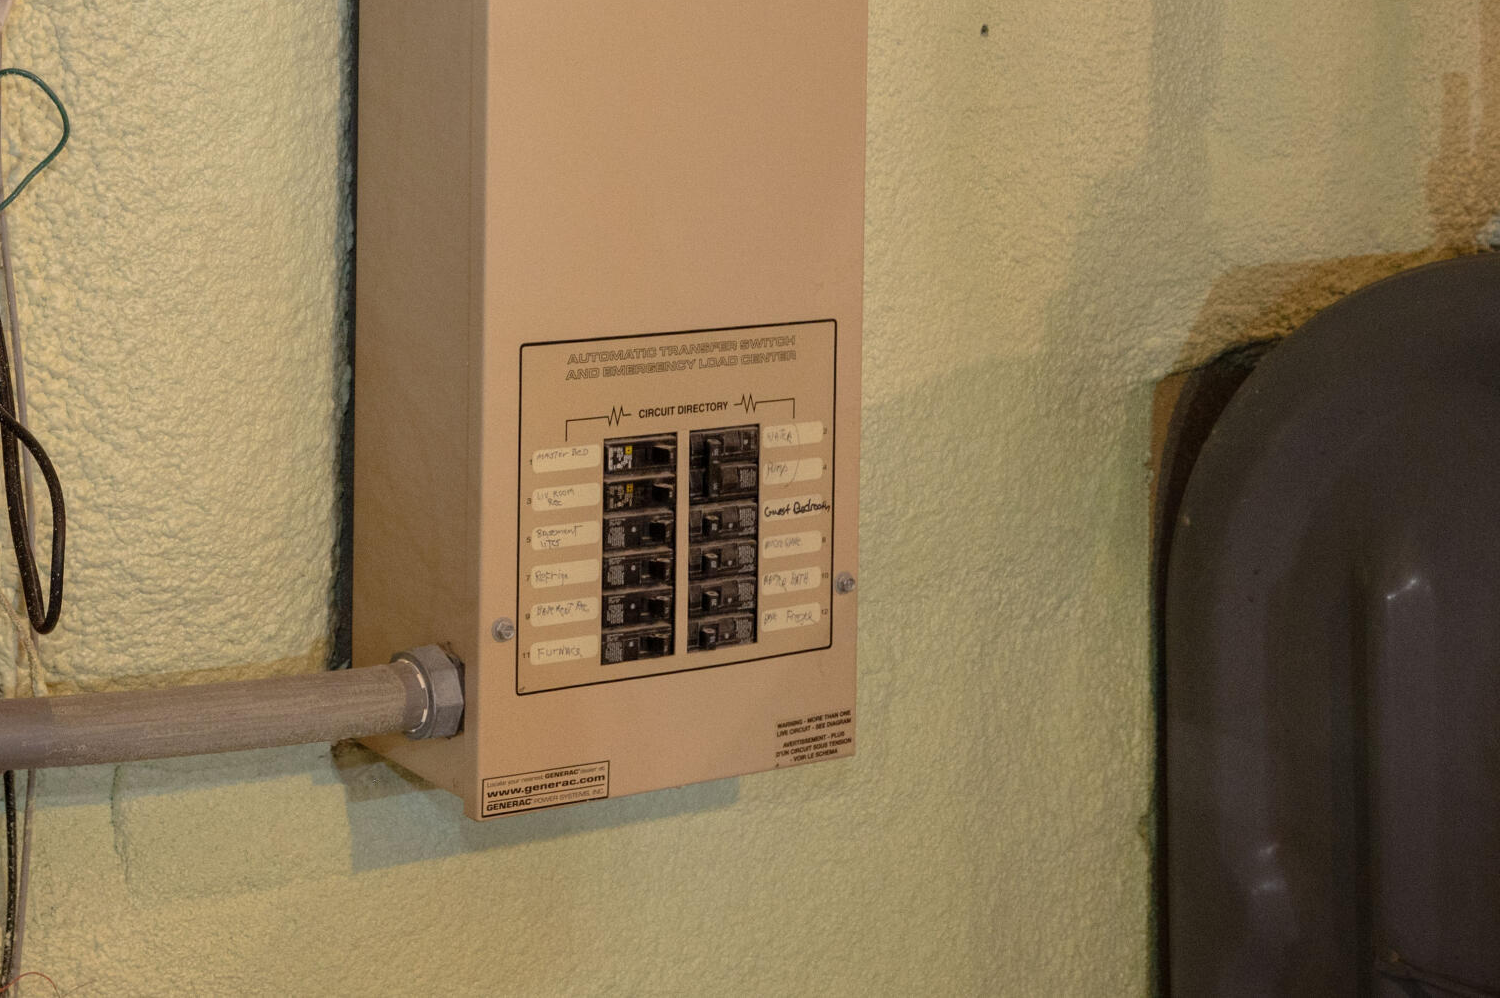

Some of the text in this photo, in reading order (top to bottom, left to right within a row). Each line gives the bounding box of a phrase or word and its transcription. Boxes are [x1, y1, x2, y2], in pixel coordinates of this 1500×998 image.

[567, 335, 796, 365] AUTOMATIC TRANSFER SWITCH
[566, 350, 797, 380] AND EMERGENCY LOAD CENTER
[638, 402, 728, 419] CIRCUIT DIRECTORY
[764, 504, 790, 517] Guest
[776, 729, 788, 737] LIVE
[789, 726, 811, 735] CIRCUIT
[826, 718, 852, 727] DIAGRAM
[783, 731, 845, 748] AVERTISSEMENT PLUS
[790, 746, 812, 754] CIRCUIT
[813, 742, 828, 750] SOUS
[829, 738, 852, 747] TENSION
[544, 769, 579, 779] GENERAC
[487, 774, 605, 798] www.generac.com
[486, 798, 532, 812] GENERAC
[534, 796, 559, 804] POWER
